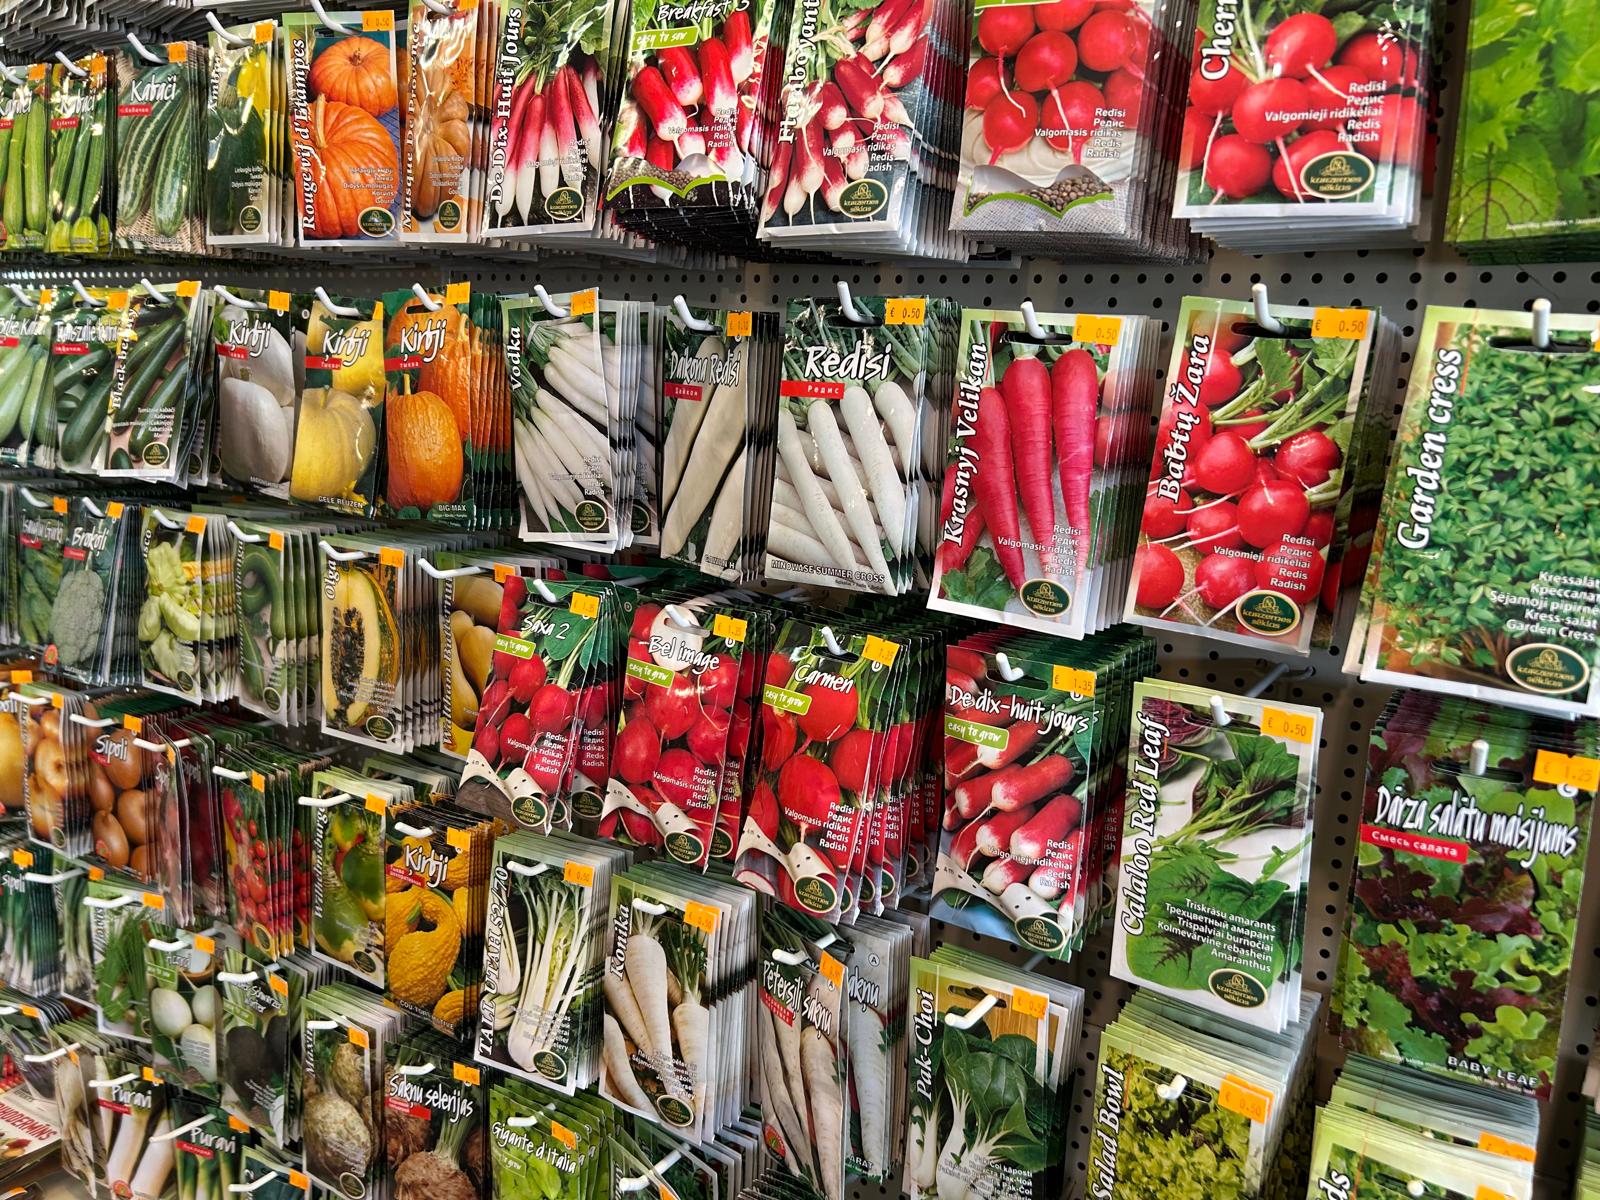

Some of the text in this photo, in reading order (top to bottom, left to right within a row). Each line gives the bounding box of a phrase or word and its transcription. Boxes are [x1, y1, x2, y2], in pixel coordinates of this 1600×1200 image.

[130, 74, 178, 103] Kabači
[1346, 94, 1384, 106] Редис
[1093, 118, 1125, 128] Редис
[1265, 108, 1328, 122] Valgomieji
[1347, 119, 1381, 131] Redis
[1034, 127, 1122, 138] Valgomasis ridikas
[1094, 138, 1121, 148] Redis
[1337, 131, 1379, 143] Radish
[1086, 148, 1120, 159] Radish
[489, 161, 505, 204] De
[301, 171, 318, 230] Rouge
[902, 306, 921, 319] 0.50
[1096, 327, 1117, 340] 0.50
[1338, 319, 1364, 334] 0.50
[229, 319, 272, 357] Ķirbji
[321, 327, 371, 367] Ķirbji
[400, 319, 447, 363] Ķirbji
[507, 326, 522, 391] Vodka
[1170, 334, 1211, 409] Žara
[807, 384, 840, 395] Редис
[943, 342, 987, 547] Krasnyj Velikan
[1396, 347, 1463, 550] Garden cress
[451, 503, 467, 513] MAX
[997, 536, 1079, 557] Valgomasis ridikas
[1213, 545, 1265, 563] Valgomieji
[1279, 544, 1313, 558] Редис
[324, 560, 340, 601] Olga
[771, 558, 814, 574] MINOWASE
[815, 565, 853, 580] SUMMER
[854, 571, 886, 585] CROSS
[1278, 567, 1308, 581] Redis
[1270, 576, 1306, 591] Radish
[521, 614, 570, 641] Saxa 2
[1506, 618, 1595, 642] Garden Cress
[1524, 609, 1597, 630] Kress-salat
[648, 636, 720, 674] Bel image
[643, 666, 651, 675] to
[794, 664, 855, 694] Carmen
[1073, 677, 1093, 692] 1.35
[765, 690, 804, 708] easy to grow
[975, 688, 1046, 724] dix-huit
[1037, 707, 1090, 736] jours
[947, 722, 1002, 743] easy to grow
[1283, 720, 1307, 738] 0.50
[538, 746, 564, 759] ridikas
[541, 757, 562, 768] Redis
[534, 763, 559, 776] Radish
[653, 771, 689, 789] Valgomasis
[1565, 765, 1594, 783] 1.25
[692, 775, 716, 786] Редис
[686, 799, 712, 810] Radish
[784, 806, 852, 834] Valgomasis ridikas
[827, 811, 853, 825] Редис
[1120, 710, 1171, 937] Calaloo Red Leaf
[819, 839, 848, 852] Radish
[826, 830, 849, 843] Redis
[1371, 829, 1458, 857] Смесь салата
[1045, 848, 1073, 861] Редис
[405, 845, 449, 889] Ķirbji
[1165, 902, 1276, 943] Трехцветный амарант
[1177, 916, 1226, 939] Trispalviai
[1228, 911, 1276, 933] amarants
[610, 903, 630, 981] Konika
[1222, 941, 1272, 964] rebashein
[484, 933, 504, 995] UTAH
[1210, 947, 1272, 973] Amaranthus
[912, 988, 934, 1103] Pak-Choi
[1447, 1055, 1492, 1075] BABY
[1497, 1068, 1538, 1088] LEAF
[111, 1084, 152, 1109] Puravi
[424, 1083, 474, 1123] selerijas
[1239, 1096, 1262, 1117] 0.50
[190, 1127, 237, 1154] Puravi
[1093, 1063, 1126, 1200] Salad Bowl
[492, 1121, 579, 1175] Gigante d'Italia
